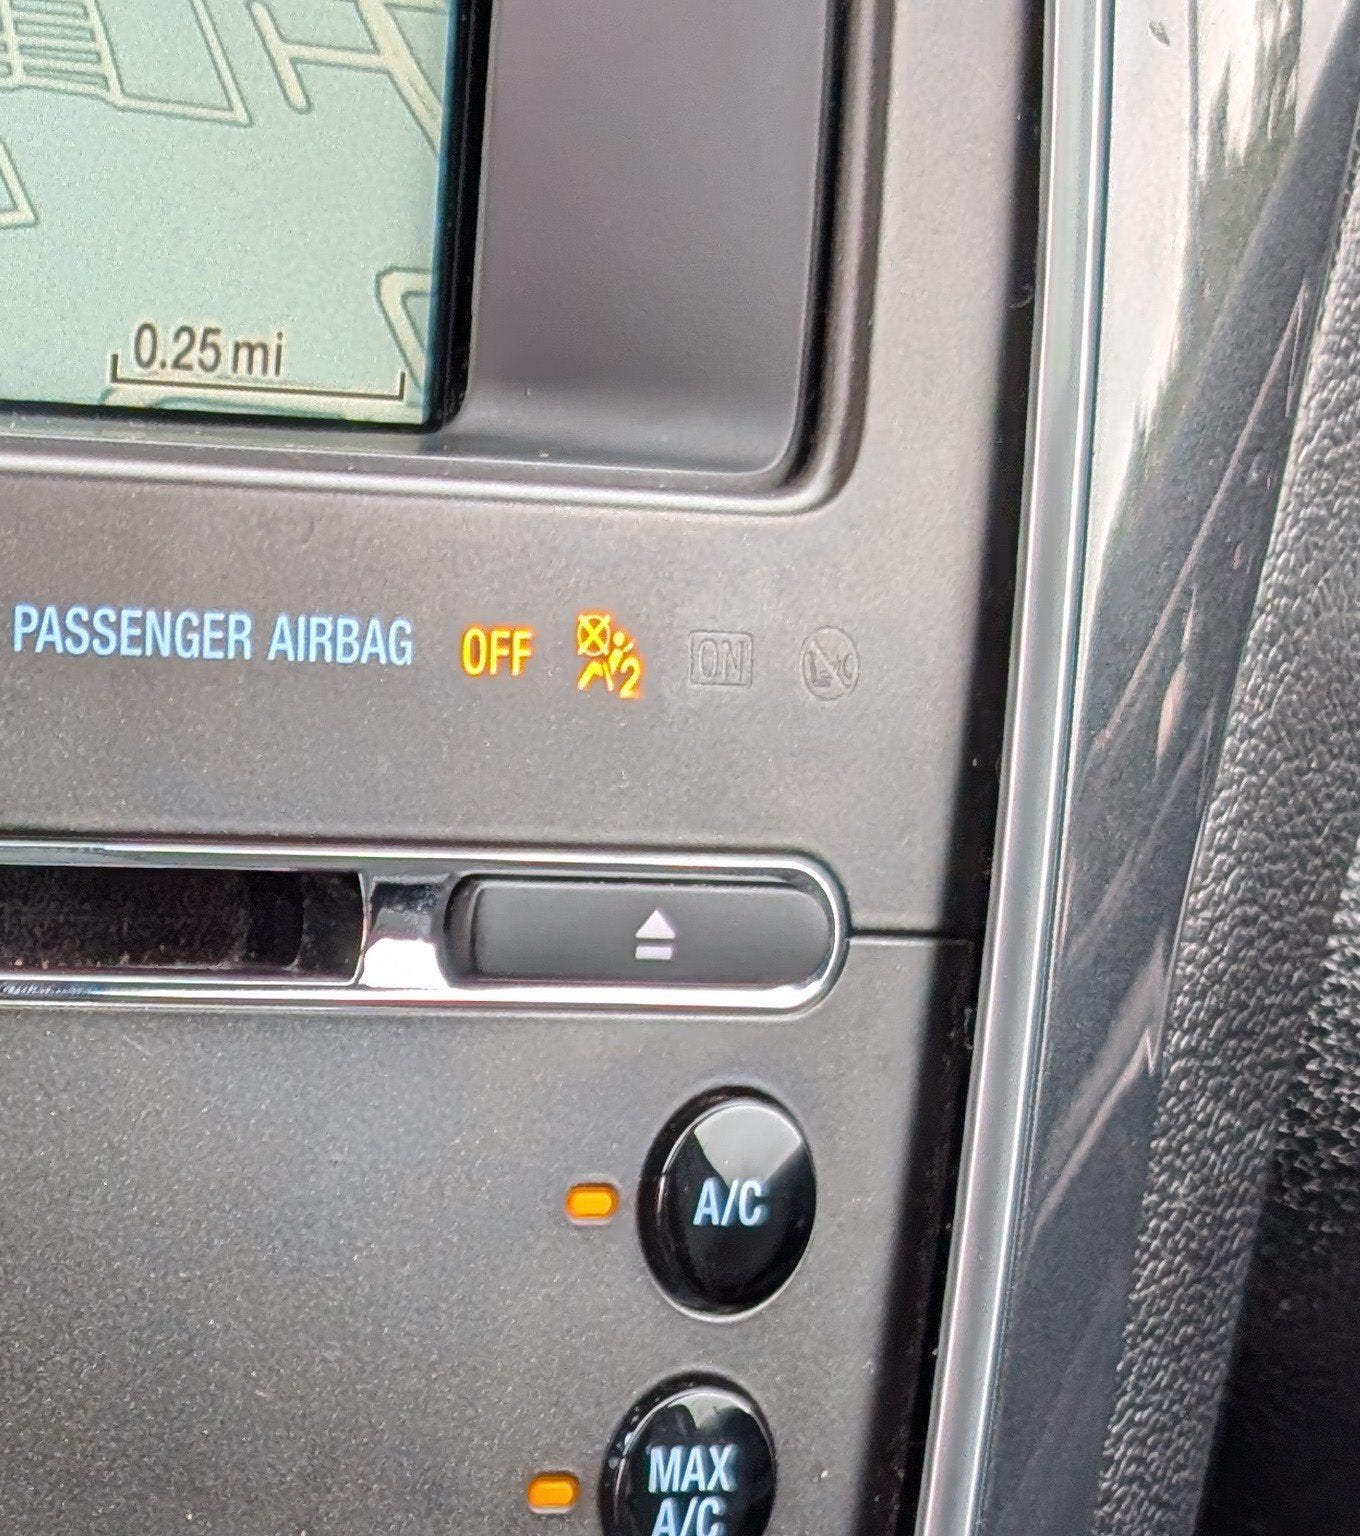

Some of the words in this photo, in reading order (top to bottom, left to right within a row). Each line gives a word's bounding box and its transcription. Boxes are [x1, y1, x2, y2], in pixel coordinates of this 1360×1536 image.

[134, 323, 221, 374] 0.25
[232, 332, 283, 377] mi
[12, 604, 252, 660] PASSENGER
[268, 613, 414, 666] AIRBAG
[461, 627, 533, 677] OFF
[699, 638, 744, 681] ON
[693, 1177, 764, 1227] A/C
[648, 1444, 735, 1493] MAX
